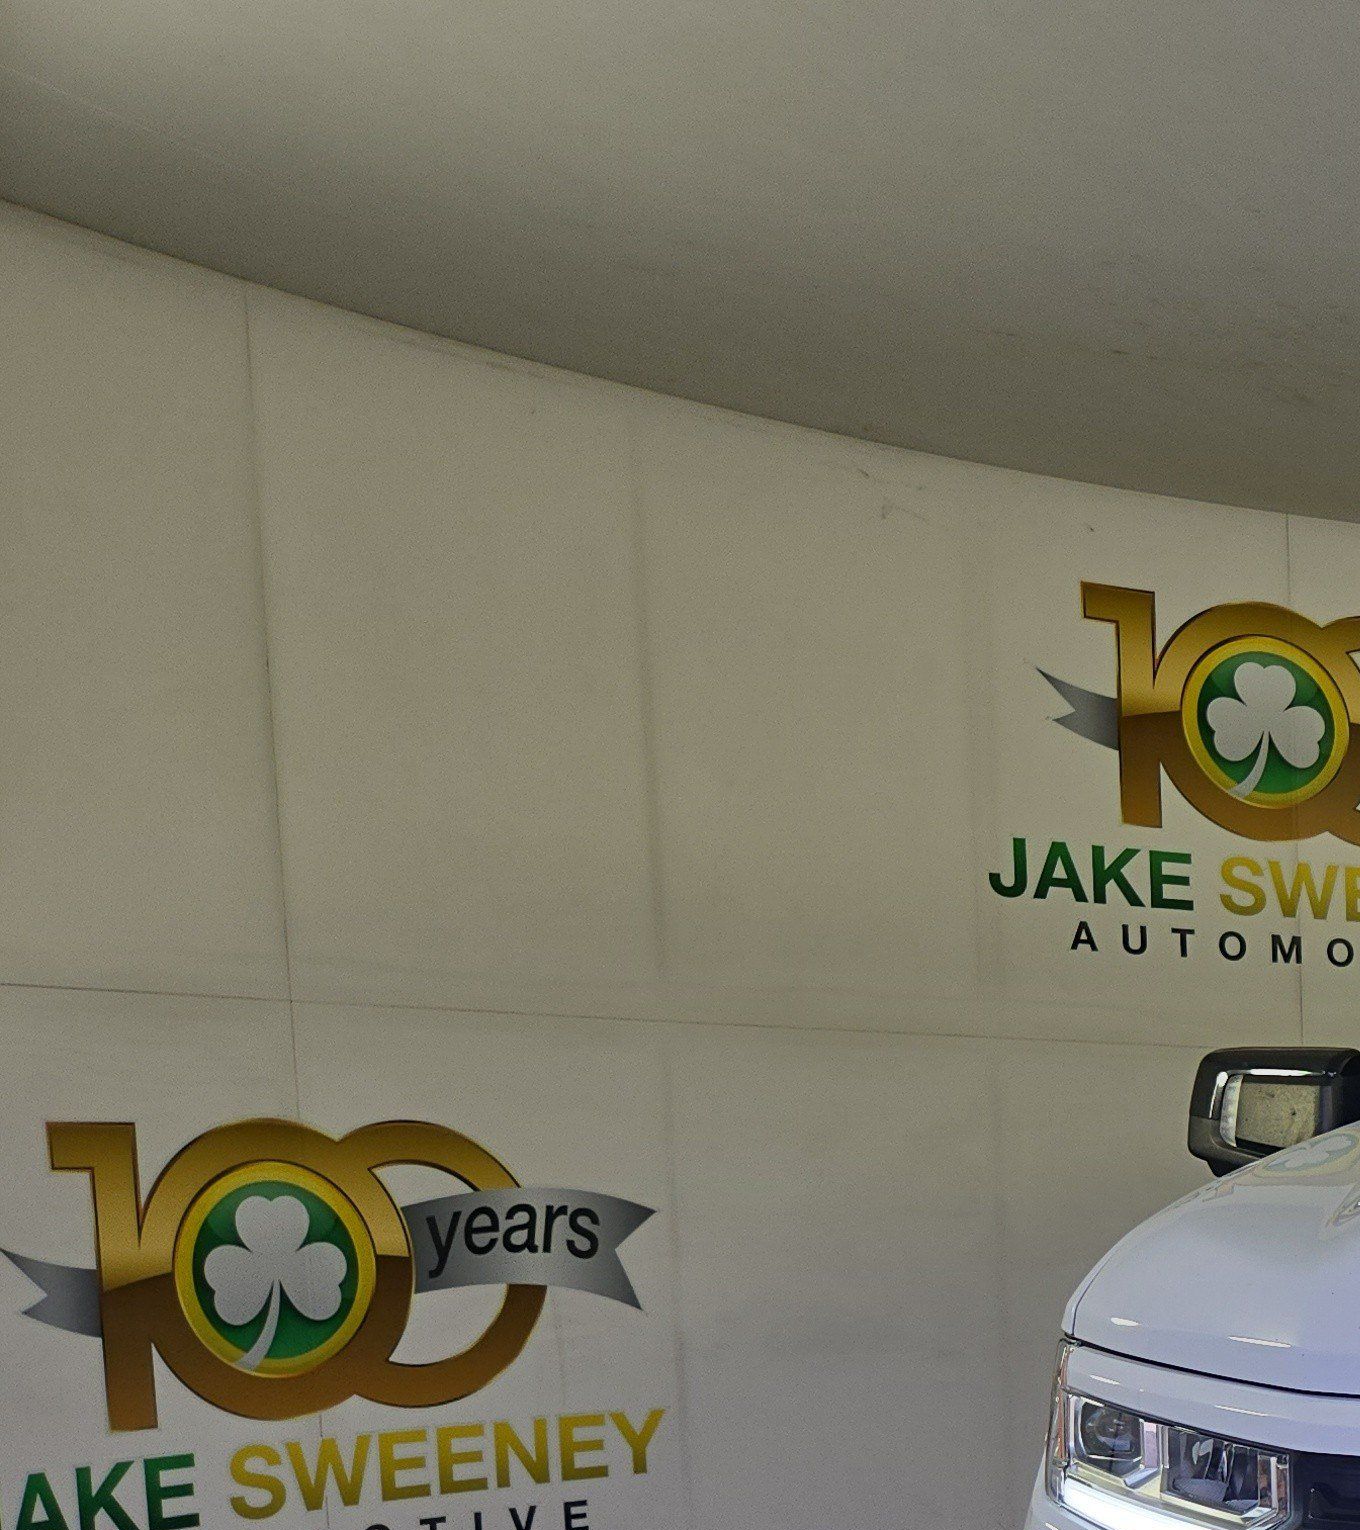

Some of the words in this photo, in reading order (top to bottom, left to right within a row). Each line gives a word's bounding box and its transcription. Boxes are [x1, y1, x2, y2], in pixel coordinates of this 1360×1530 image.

[988, 836, 1195, 911] JAKE
[45, 1117, 548, 1432] 100
[425, 1201, 601, 1278] years
[228, 1408, 666, 1521] SWEENEY
